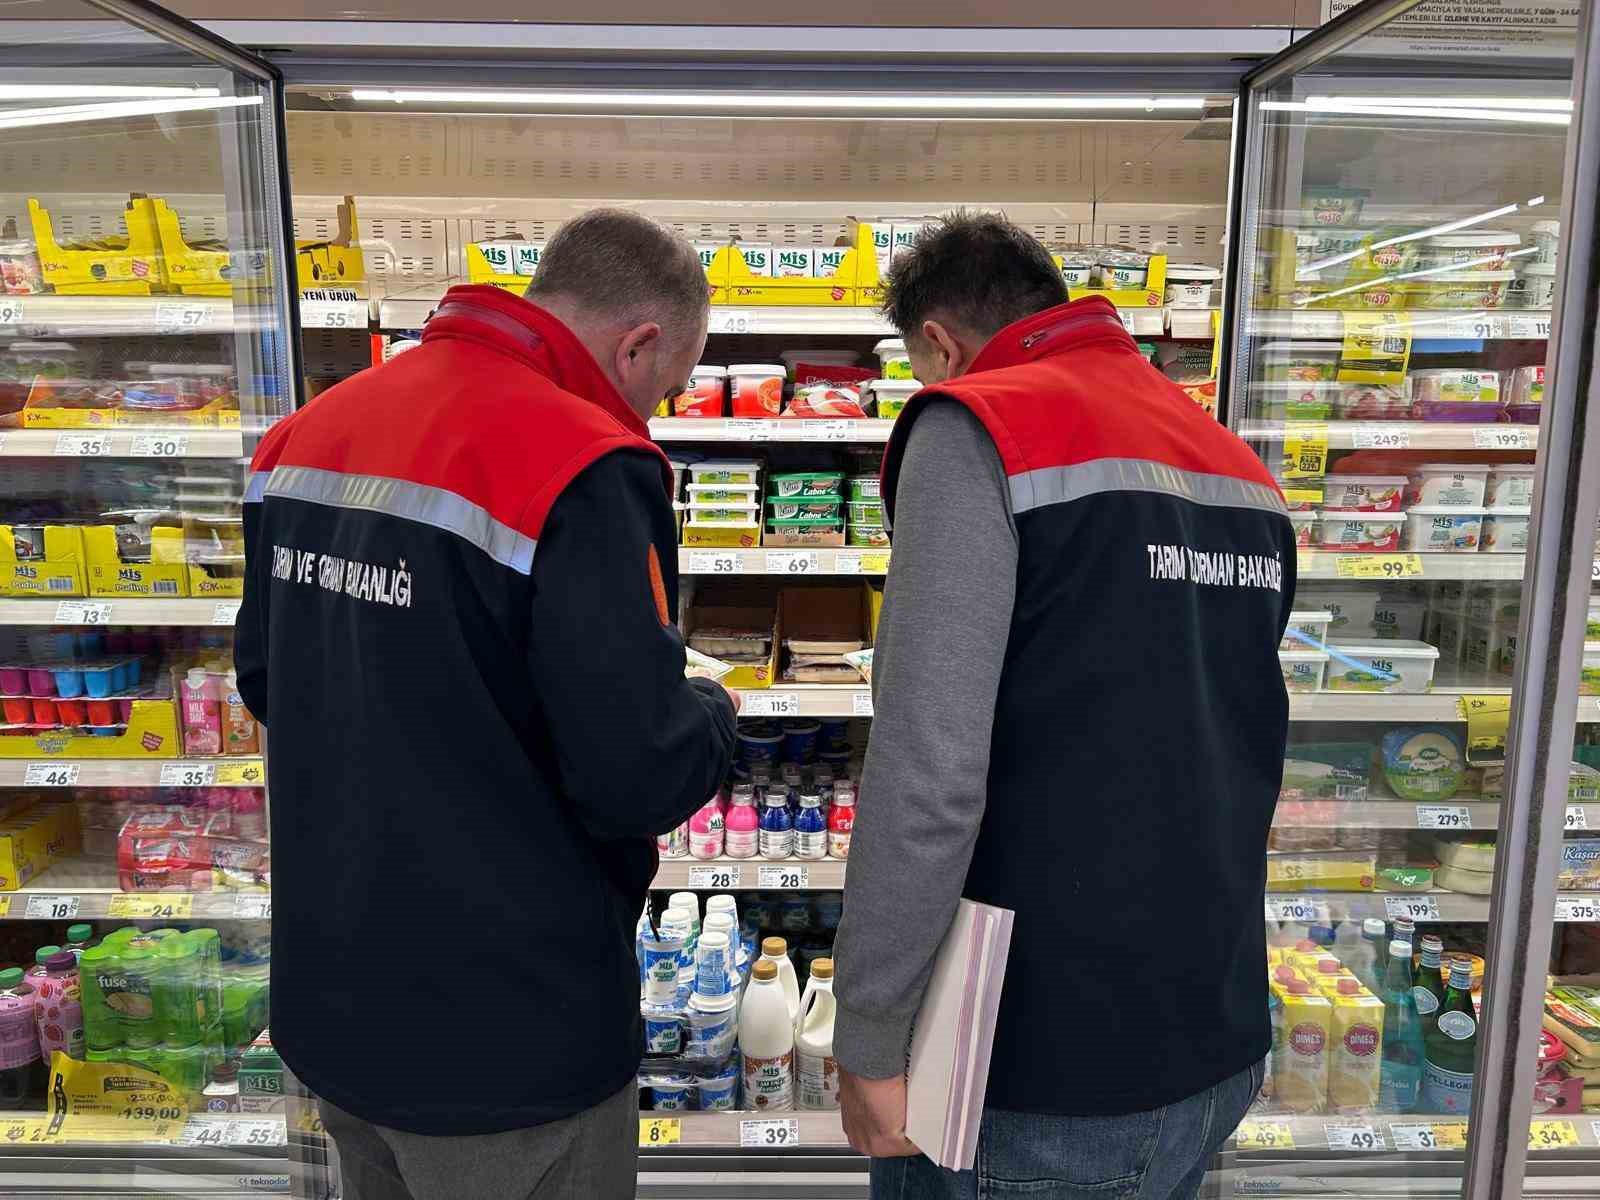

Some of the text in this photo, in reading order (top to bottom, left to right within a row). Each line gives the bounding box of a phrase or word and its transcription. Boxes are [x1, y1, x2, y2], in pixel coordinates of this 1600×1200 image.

[303, 290, 358, 302] YENİ ÜRÜN
[182, 311, 204, 325] 57
[325, 312, 346, 327] 55
[1474, 324, 1491, 338] 91
[1374, 434, 1400, 446] 249
[1496, 434, 1519, 446] 199
[80, 441, 101, 455] 35
[152, 442, 177, 457] 30
[297, 550, 316, 584] VE
[714, 560, 734, 572] 53
[788, 559, 809, 572] 69
[1148, 544, 1186, 581] TARIM
[1382, 562, 1404, 575] 99
[82, 610, 99, 623] 13
[770, 702, 789, 713] 115
[46, 772, 68, 785] 46
[183, 772, 204, 785] 35
[1438, 814, 1459, 826] 279
[711, 874, 730, 888] 28
[780, 874, 799, 888] 28
[52, 904, 68, 918] 18
[152, 905, 174, 918] 24
[1282, 906, 1304, 918] 210
[1407, 904, 1428, 916] 199
[1571, 906, 1593, 918] 375
[98, 976, 128, 988] fuse
[196, 1129, 222, 1144] 44
[246, 1129, 269, 1143] 55
[650, 1128, 660, 1142] 8
[765, 1128, 788, 1145] 39
[1255, 1132, 1276, 1145] 49
[1350, 1132, 1374, 1149] 49
[1540, 1130, 1562, 1144] 34
